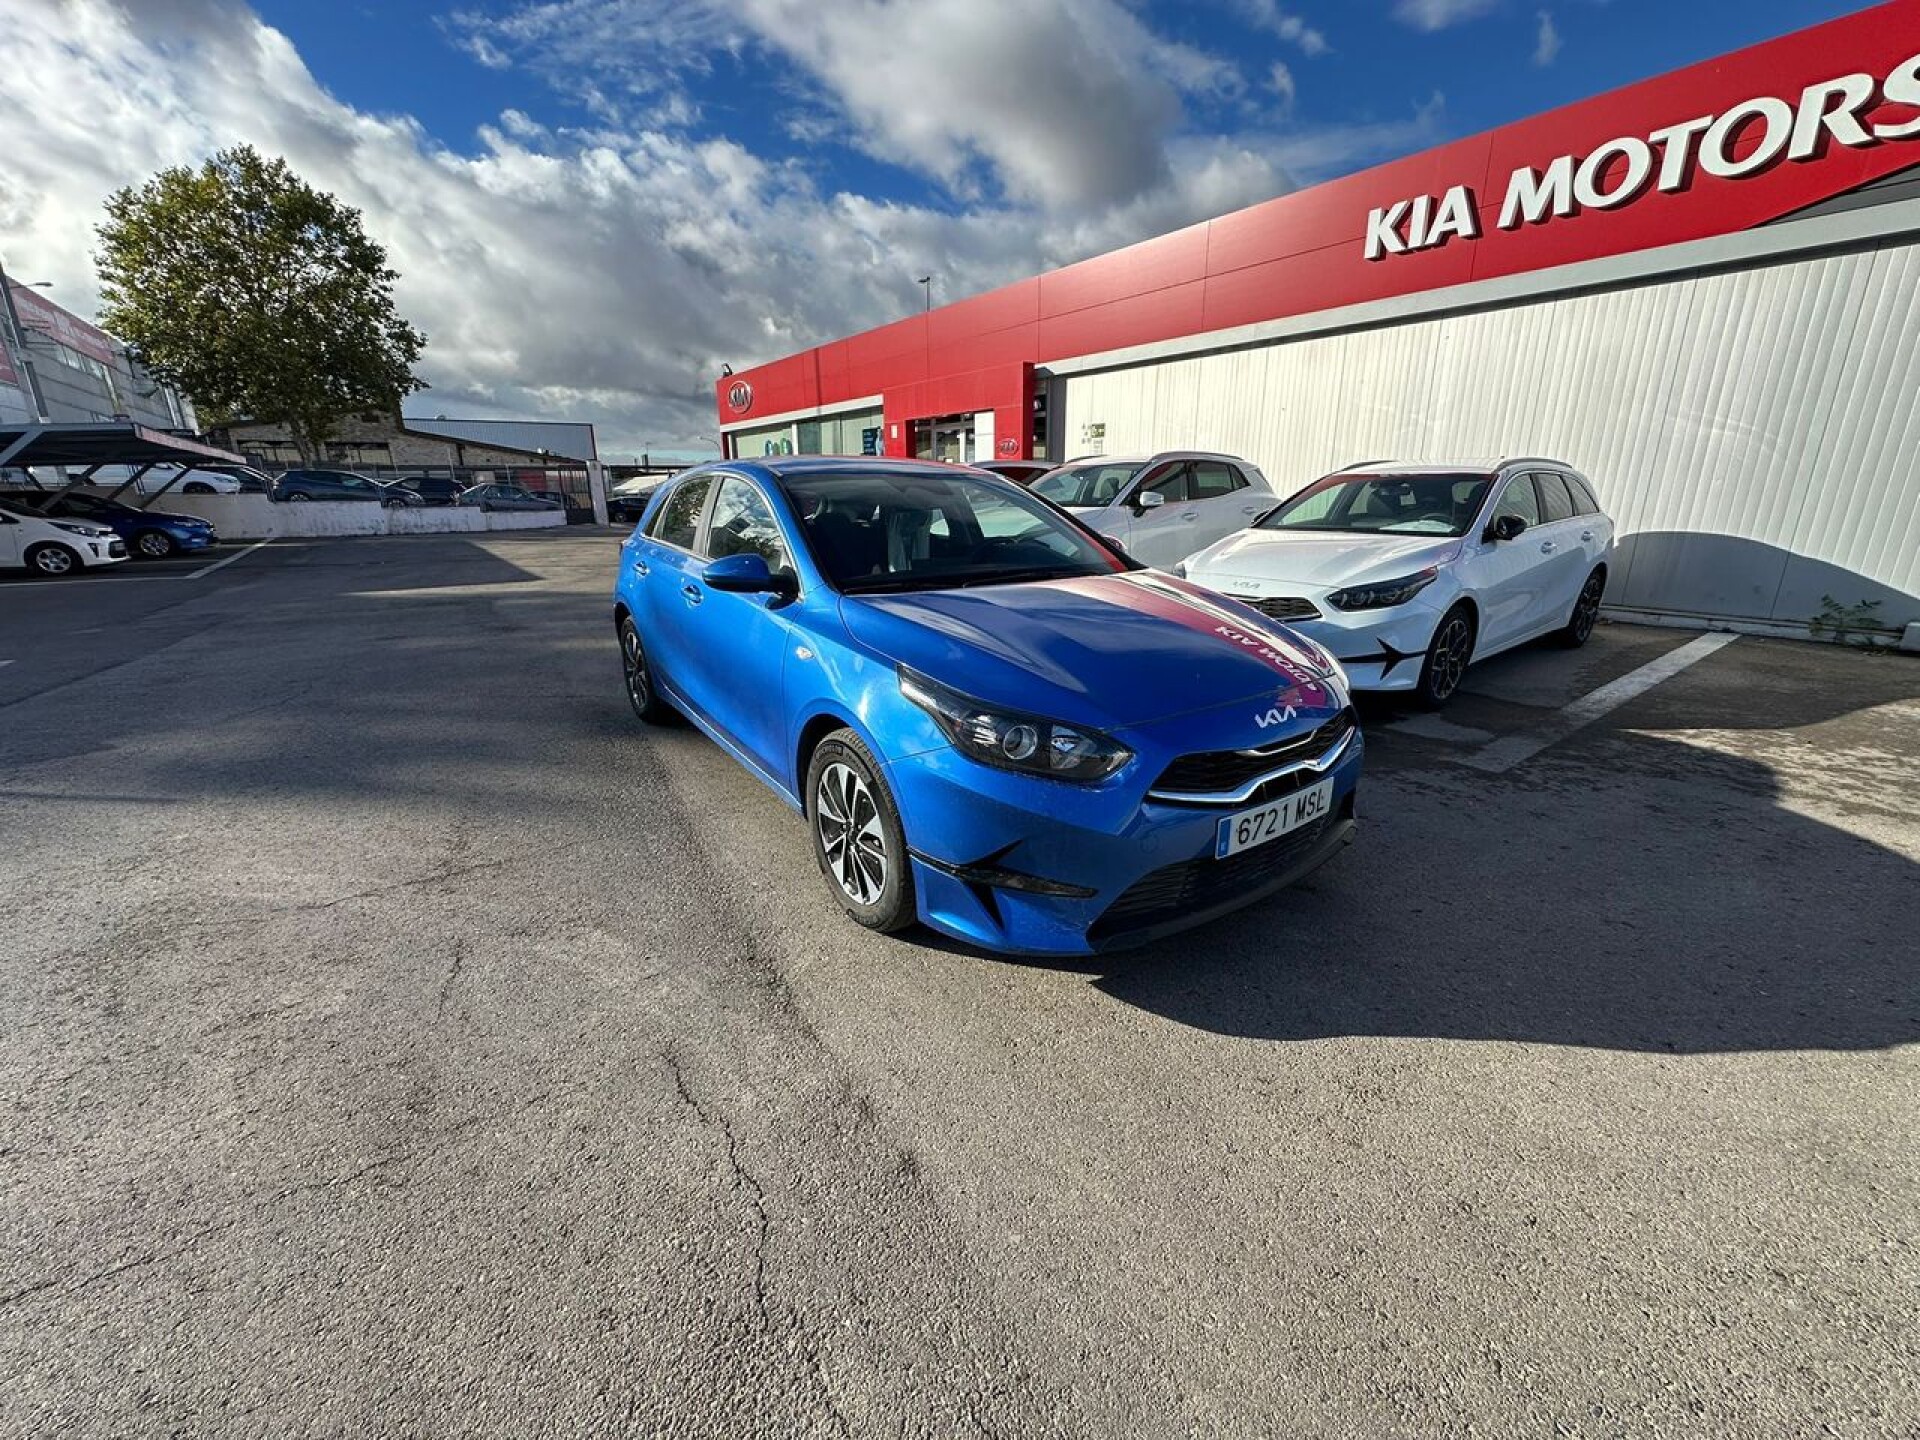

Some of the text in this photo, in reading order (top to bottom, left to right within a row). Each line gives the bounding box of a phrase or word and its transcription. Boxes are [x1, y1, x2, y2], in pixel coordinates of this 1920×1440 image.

[1363, 53, 1920, 260] KIA MOTORS
[1255, 705, 1297, 728] KIA
[1236, 788, 1325, 845] 6721 MSL
